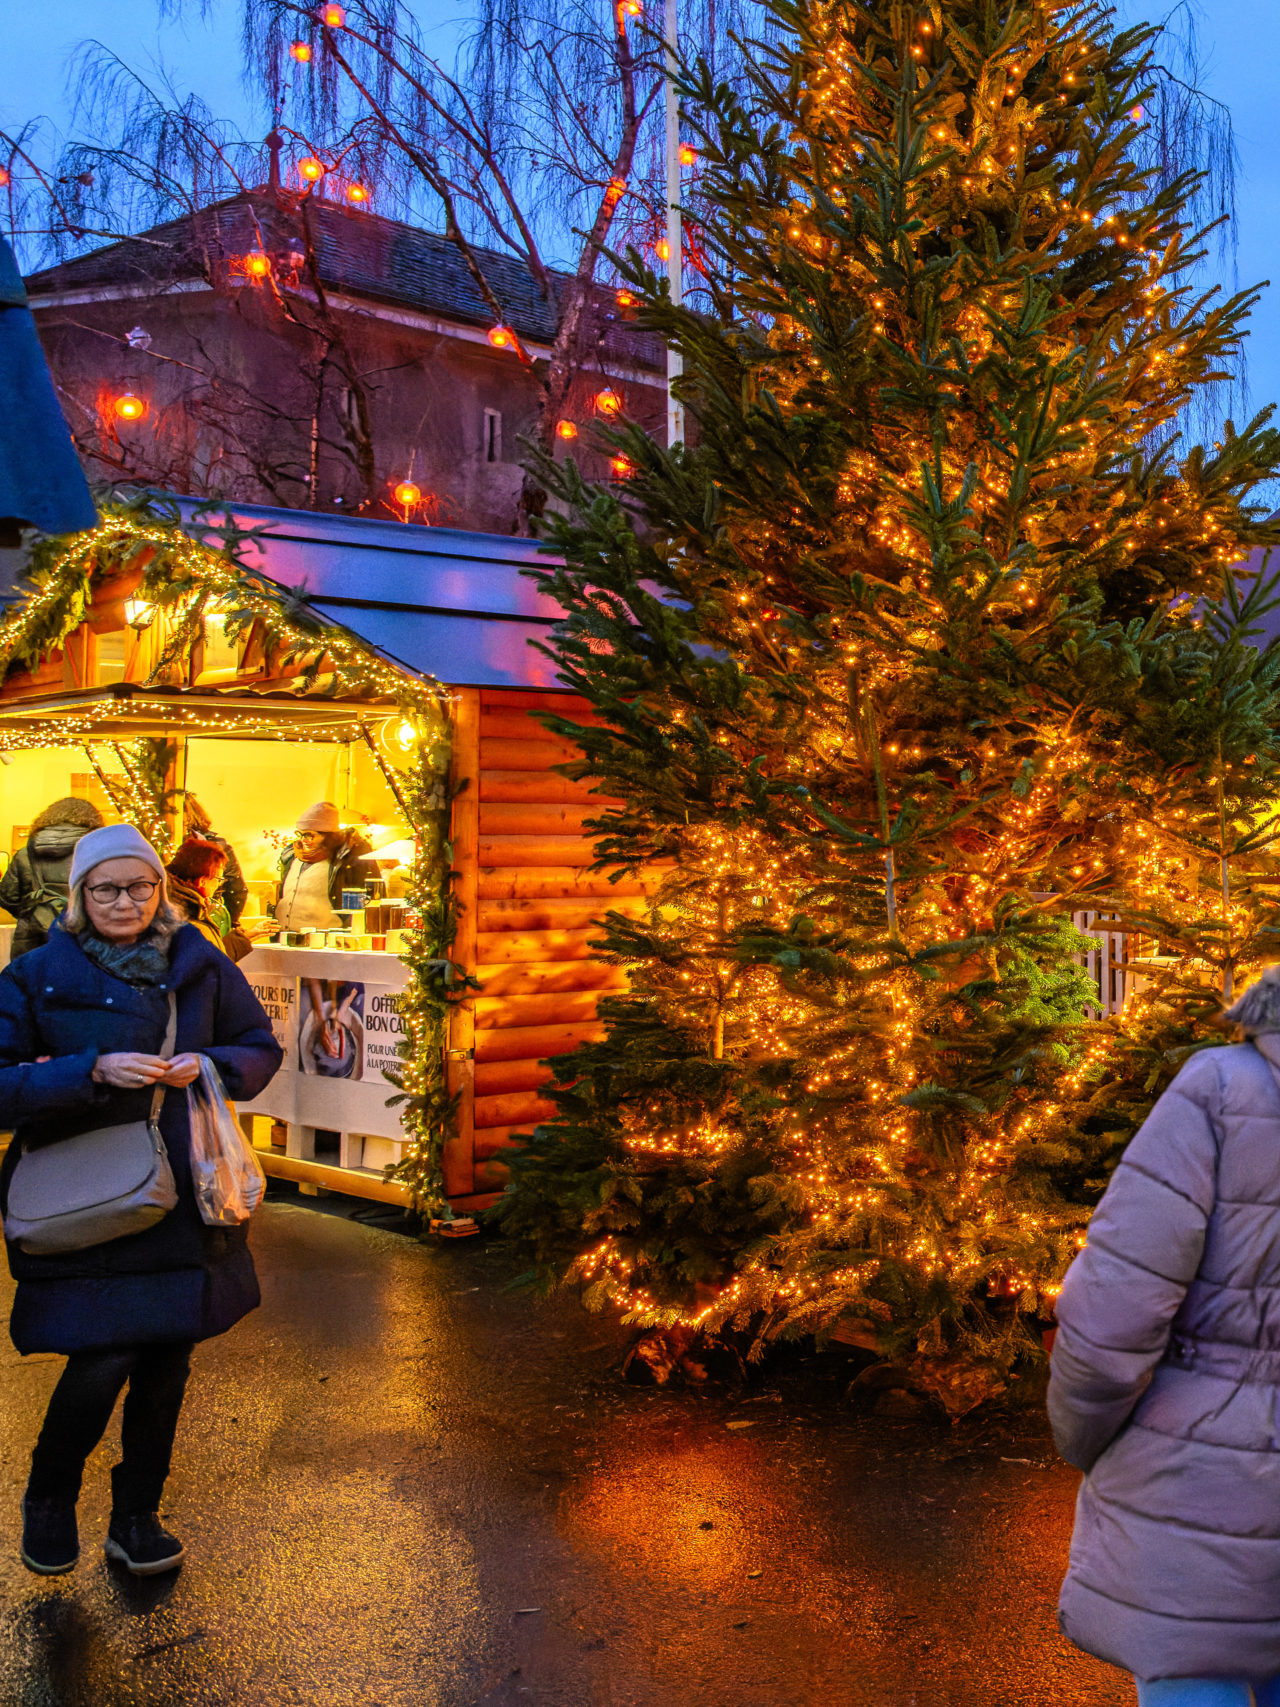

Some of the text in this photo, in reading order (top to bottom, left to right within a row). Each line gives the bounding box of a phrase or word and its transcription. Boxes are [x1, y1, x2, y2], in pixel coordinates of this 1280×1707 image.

[251, 985, 295, 1003] OURS DE
[264, 1003, 289, 1021] TERIE
[366, 1015, 389, 1032] BON
[367, 1044, 398, 1057] POUR UNE
[371, 1059, 379, 1069] LA
